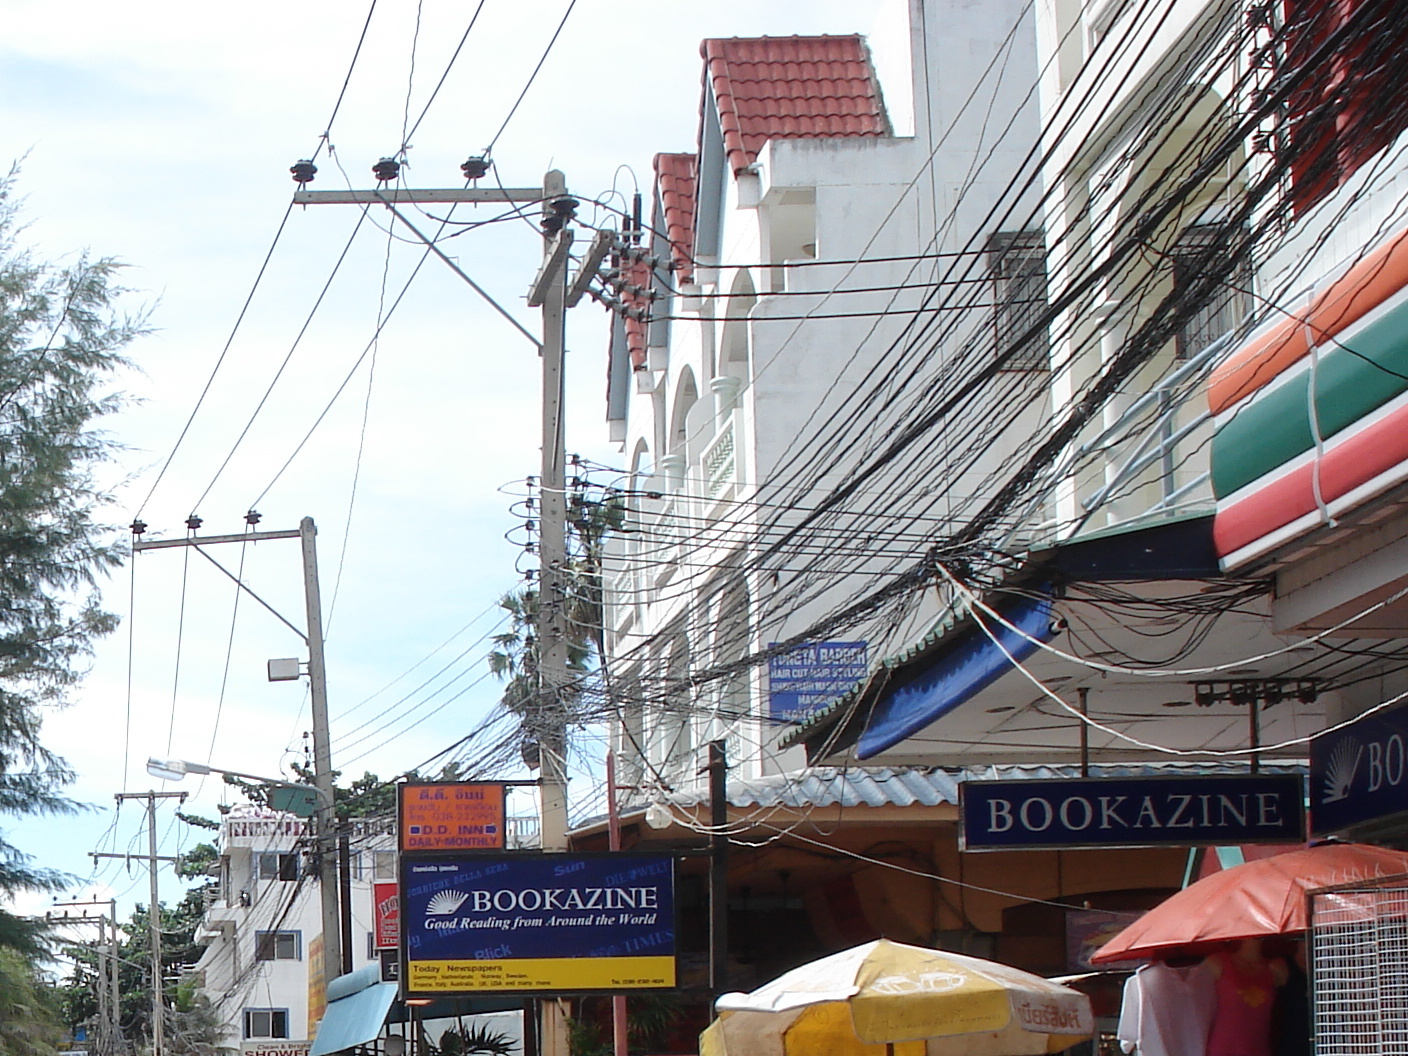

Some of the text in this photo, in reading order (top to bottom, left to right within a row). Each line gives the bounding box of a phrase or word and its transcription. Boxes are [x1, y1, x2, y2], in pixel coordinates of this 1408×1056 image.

[792, 668, 809, 678] CUT
[1368, 733, 1408, 793] BO
[987, 792, 1284, 833] BOOKAZINE
[423, 825, 483, 835] D.D. INN
[471, 886, 658, 912] BOOKAZINE
[424, 913, 657, 930] Good Reading from Around the World
[473, 944, 512, 960] Blick
[413, 964, 503, 973] Today Newspapers
